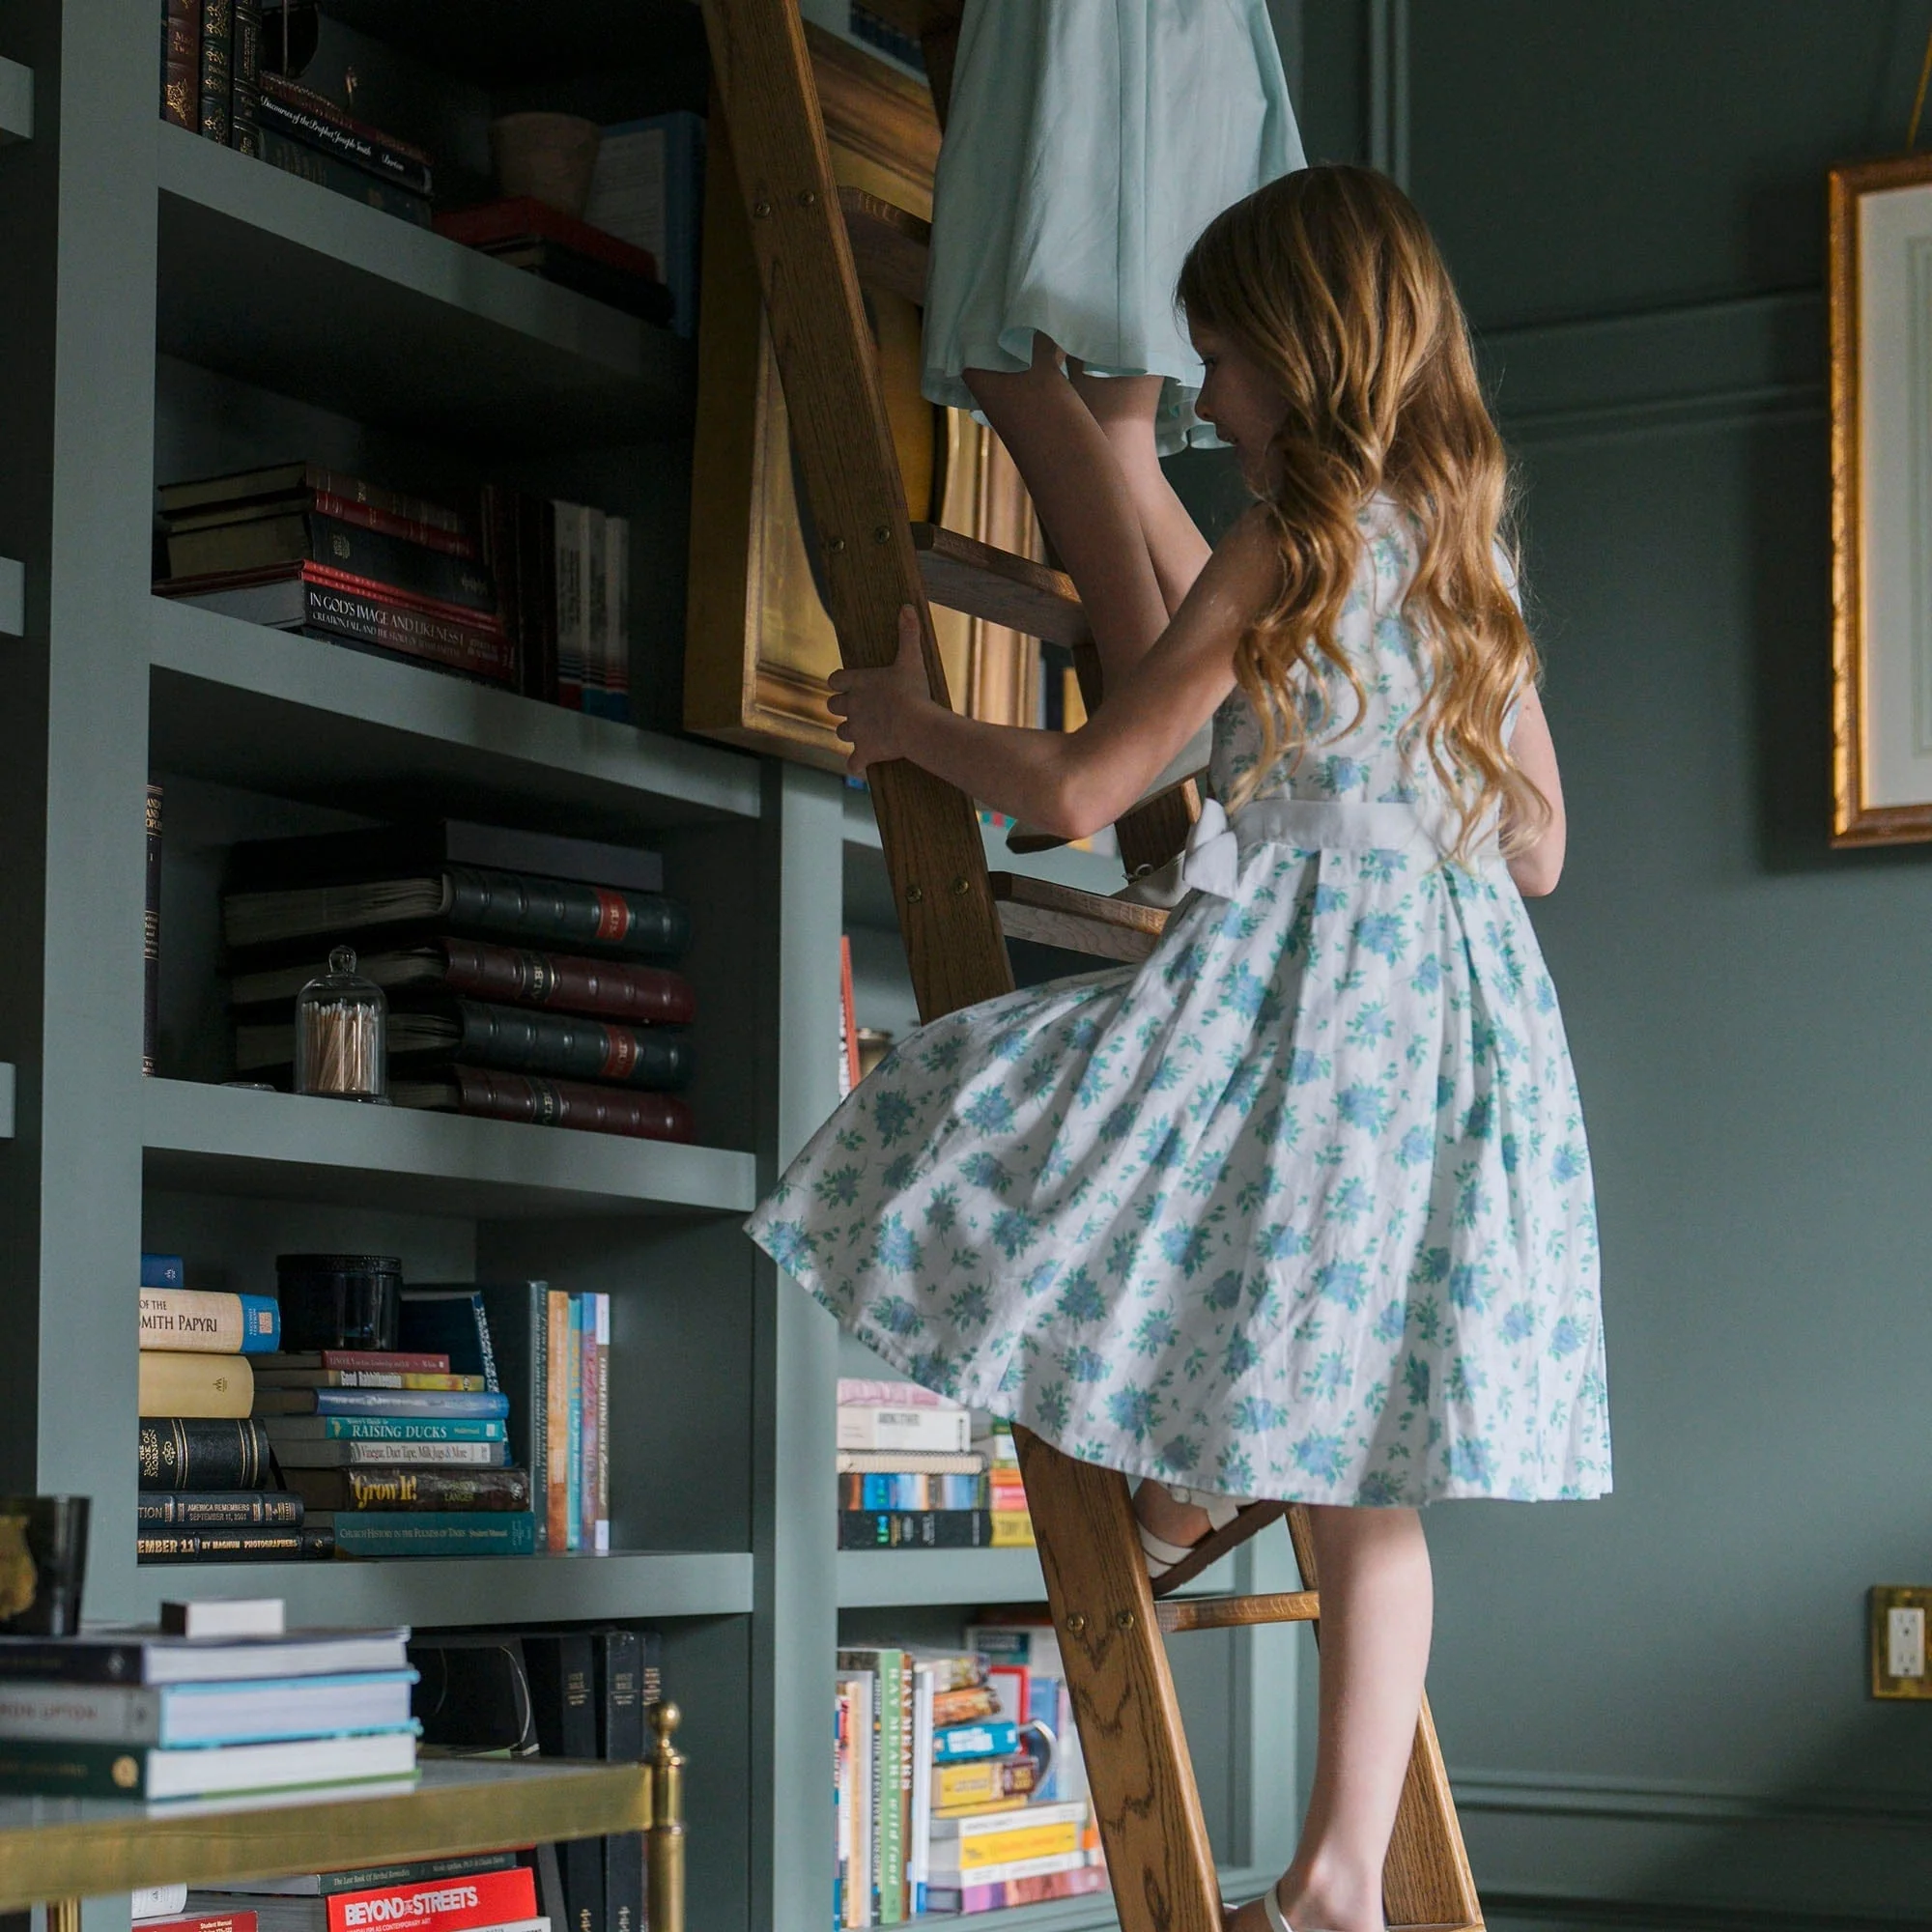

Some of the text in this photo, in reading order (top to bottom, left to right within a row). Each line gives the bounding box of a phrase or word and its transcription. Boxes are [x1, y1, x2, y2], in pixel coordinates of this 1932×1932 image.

[260, 94, 294, 120] Discourses
[308, 120, 333, 139] Prophet
[309, 591, 322, 608] IN
[323, 595, 356, 617] GOD'S
[355, 604, 388, 626] IMAGE
[391, 613, 414, 633] AND
[152, 1300, 167, 1310] THE
[139, 1315, 217, 1333] MITH PAPYRI
[142, 1429, 150, 1443] OF
[352, 1425, 402, 1438] RAISING
[406, 1426, 447, 1438] DUCKS
[149, 1429, 158, 1478] MORMON
[451, 1446, 468, 1457] More
[355, 1476, 398, 1509] Grow
[399, 1475, 417, 1501] It!
[187, 1503, 213, 1512] AMERICA
[213, 1503, 250, 1512] REMEMBERS
[189, 1513, 224, 1521] SEPTEMBER
[225, 1513, 234, 1522] 11,
[138, 1539, 298, 1553] EMBER 11 BY MAGNUM PHOTOGRAPHERS
[333, 1877, 344, 1886] The
[354, 1874, 365, 1884] Book
[345, 1896, 404, 1926] BEYOND
[412, 1887, 478, 1915] STREETS
[216, 1918, 233, 1927] Manual
[382, 1919, 421, 1931] CONTEMPORARY
